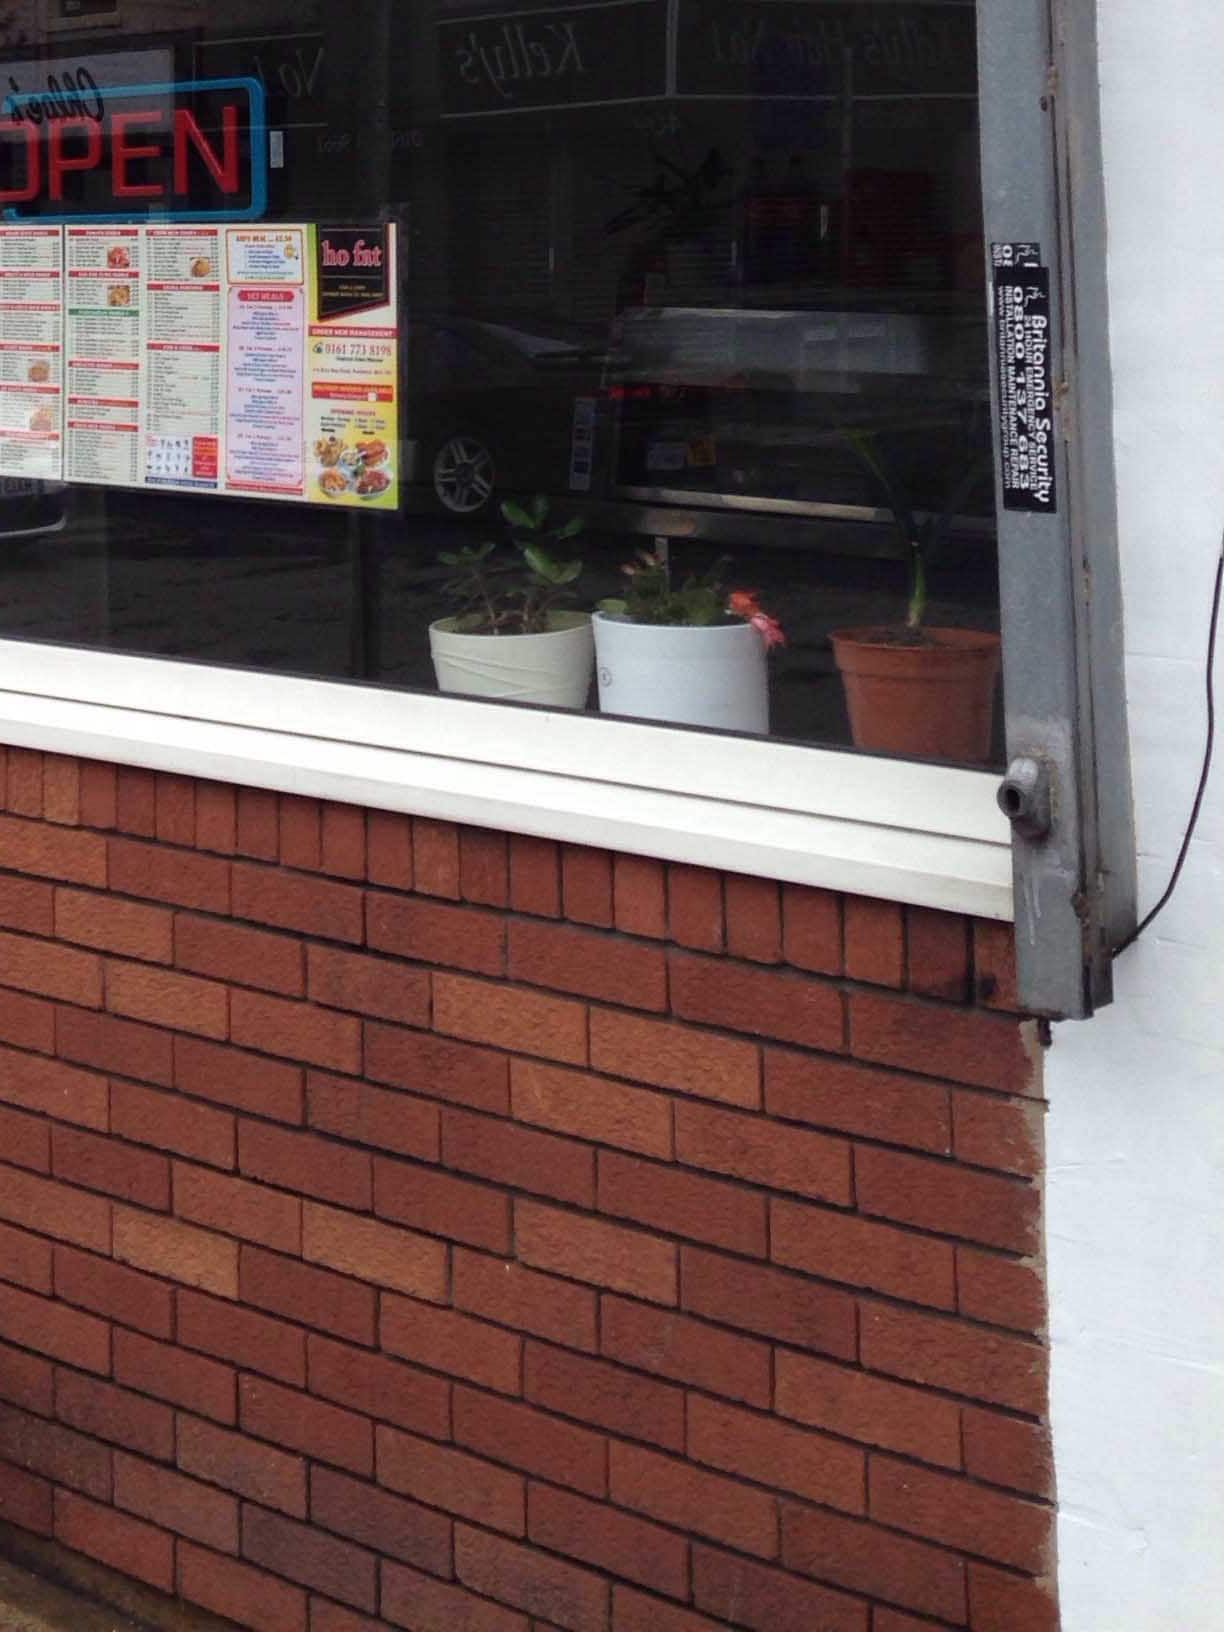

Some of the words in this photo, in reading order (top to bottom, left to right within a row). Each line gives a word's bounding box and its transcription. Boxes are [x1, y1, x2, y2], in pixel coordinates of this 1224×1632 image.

[321, 239, 350, 266] ho
[353, 239, 383, 267] fat
[1005, 286, 1016, 364] INSTALLATION
[1014, 286, 1025, 359] 0800
[1016, 371, 1027, 424] 137
[1031, 314, 1050, 411] Britannia
[1007, 366, 1018, 446] MAINTENANCE
[1025, 366, 1036, 440] EMERGENCY
[1010, 449, 1020, 489] REPAIR
[1028, 441, 1038, 490] SERVICE
[1034, 417, 1053, 503] Security
